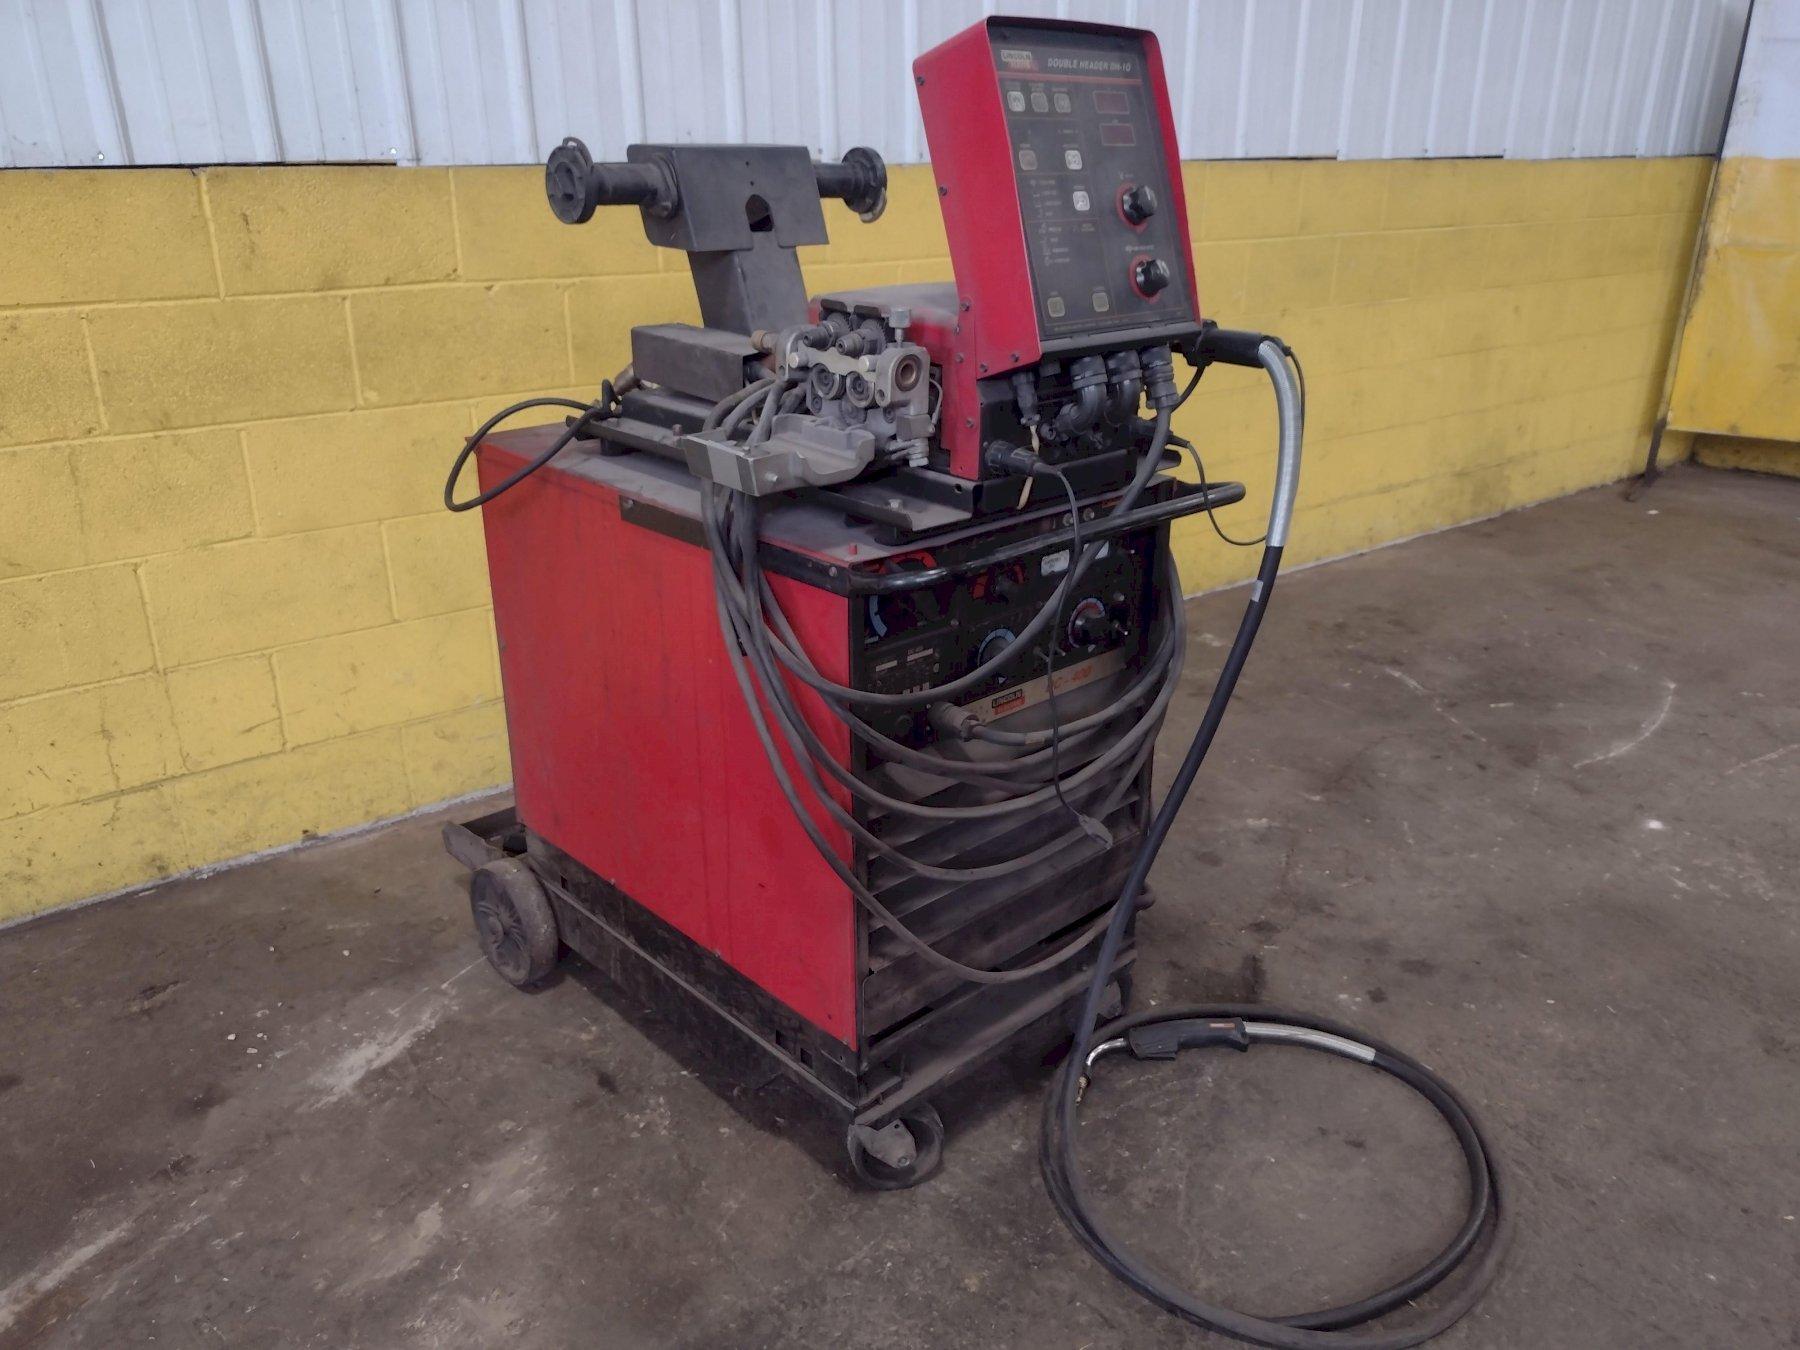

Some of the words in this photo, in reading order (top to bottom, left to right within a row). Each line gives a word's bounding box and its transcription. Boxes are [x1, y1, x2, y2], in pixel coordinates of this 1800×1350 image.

[1047, 57, 1079, 69] DOUBLE
[1079, 60, 1109, 70] HEADER
[992, 689, 1023, 708] LINCOLN
